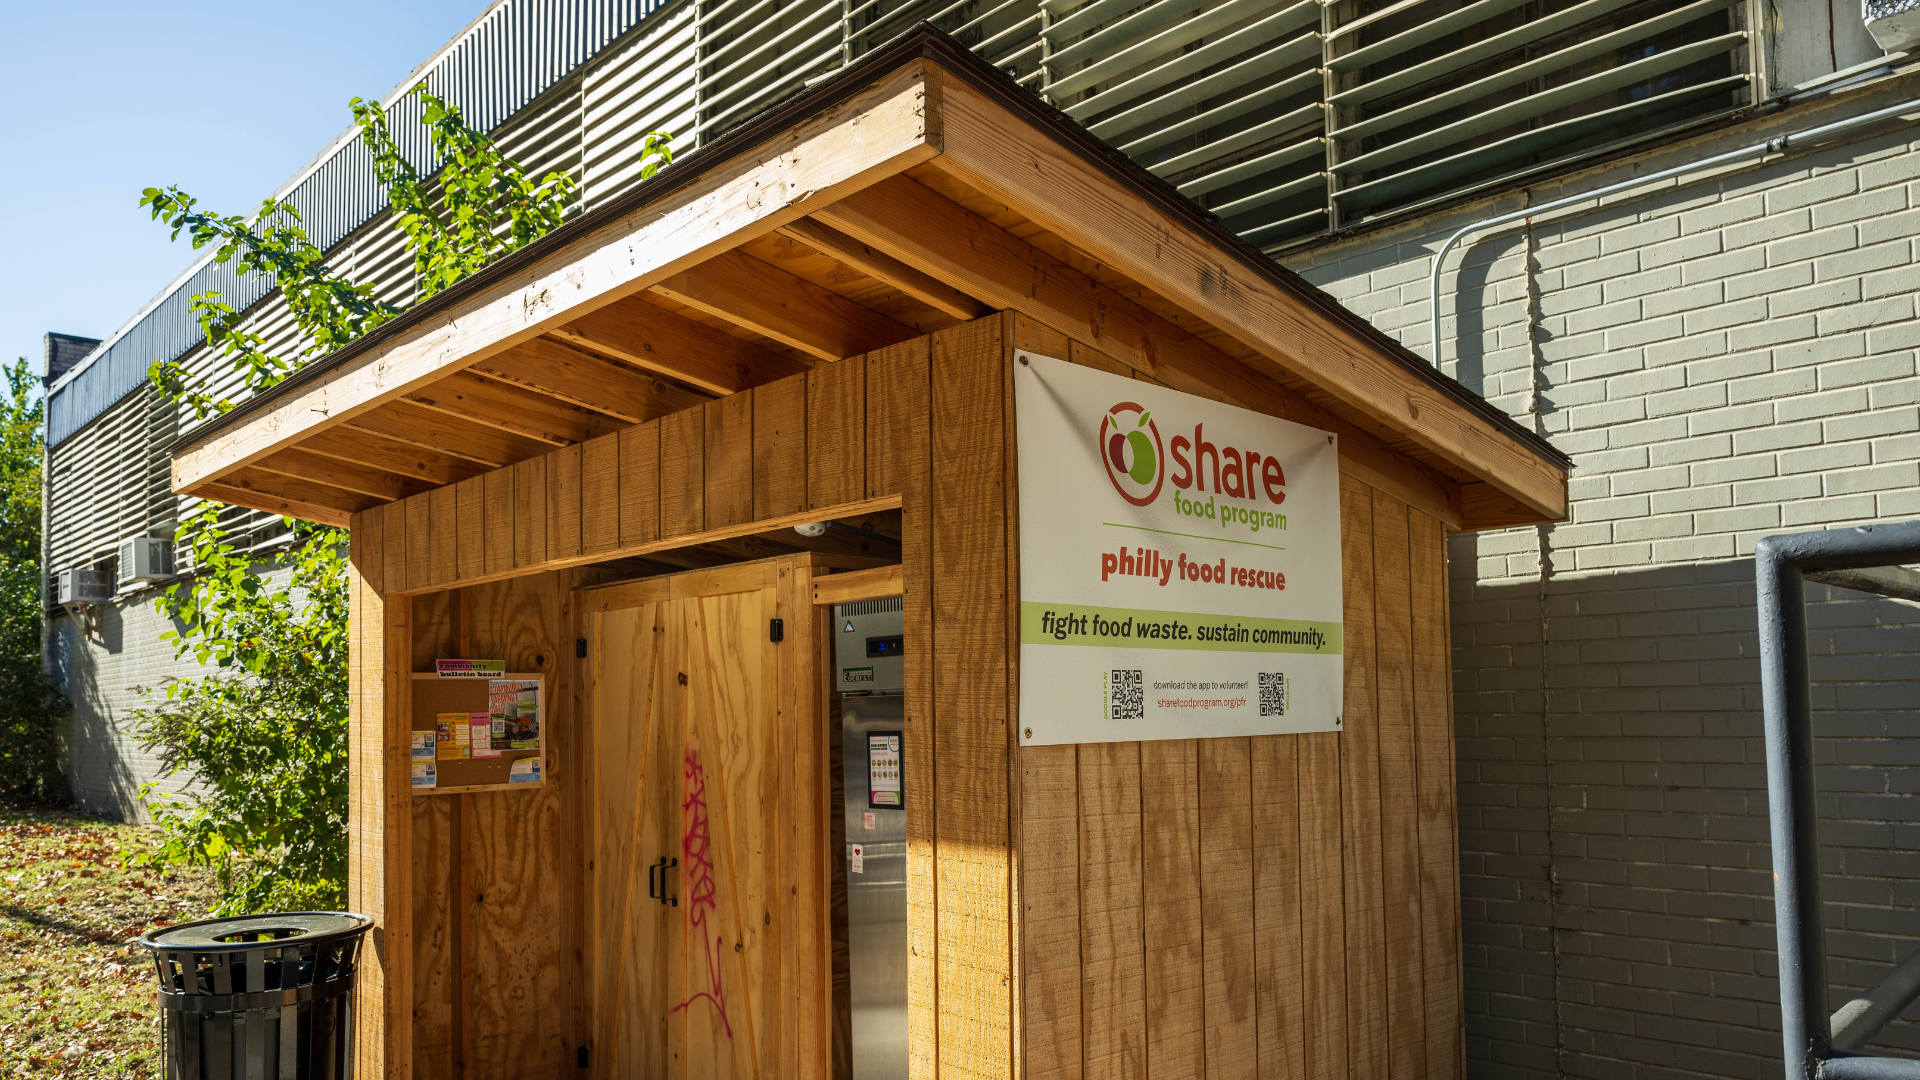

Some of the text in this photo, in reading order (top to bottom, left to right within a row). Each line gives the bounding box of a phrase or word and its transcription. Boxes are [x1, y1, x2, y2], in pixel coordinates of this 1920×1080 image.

[1170, 422, 1286, 505] share
[1174, 489, 1287, 532] food program
[1101, 546, 1286, 591] philly food rescue
[1041, 610, 1326, 650] fight food waste. sustain community.
[1153, 680, 1249, 692] download the app to volunteer!
[1157, 697, 1247, 710] sharefoodprogram.org/pfr
